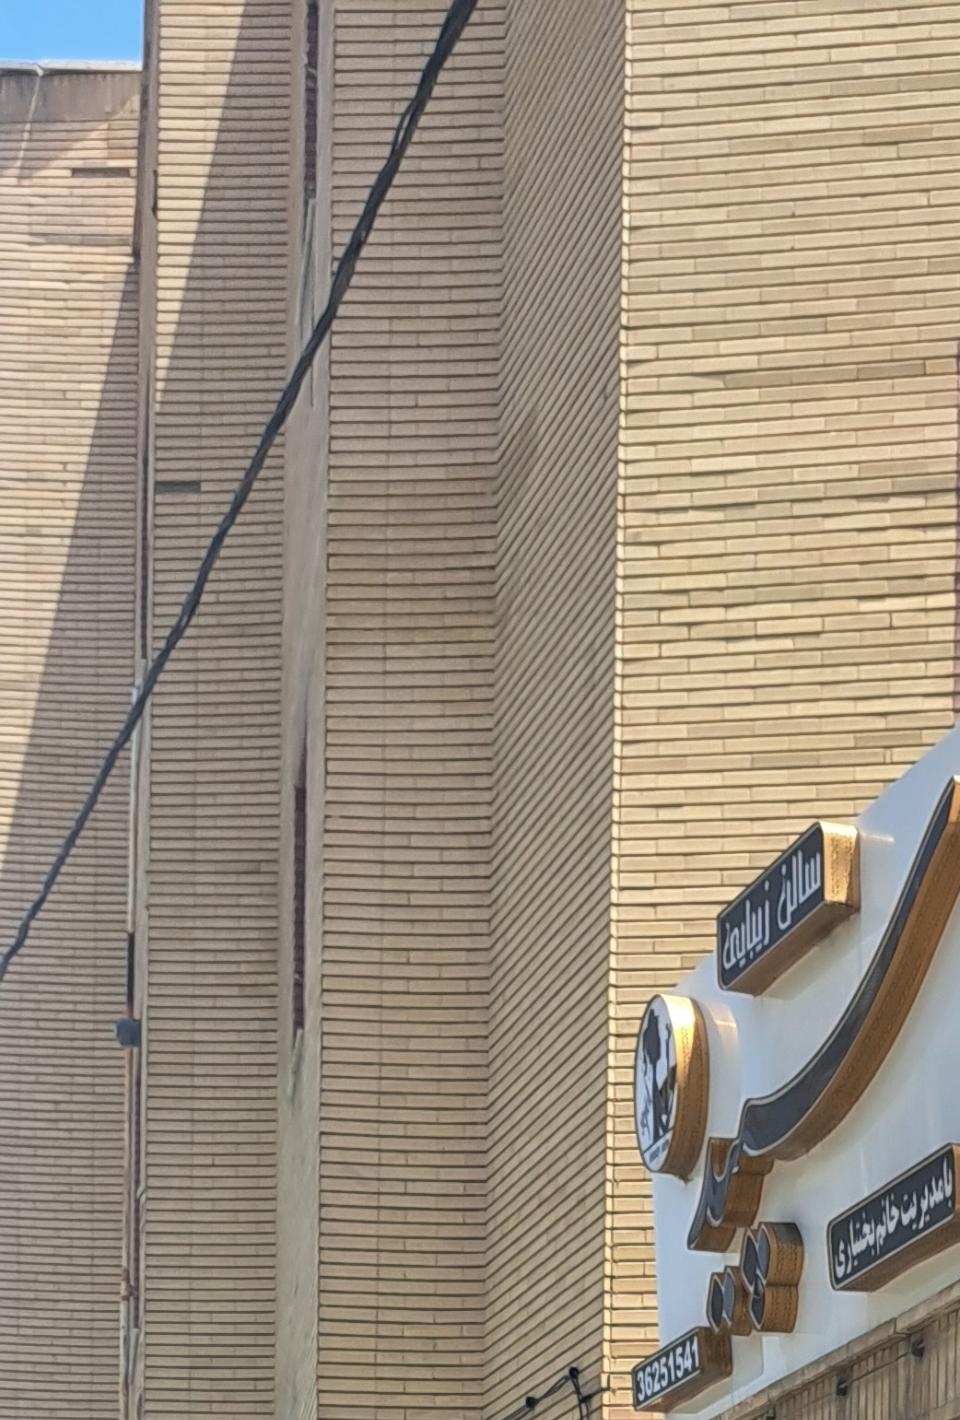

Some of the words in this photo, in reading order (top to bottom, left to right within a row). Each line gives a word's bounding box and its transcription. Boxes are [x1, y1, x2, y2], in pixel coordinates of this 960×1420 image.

[777, 850, 821, 930] سالن
[723, 880, 770, 970] زیبایی
[834, 1211, 875, 1279] بختیاری
[876, 1193, 900, 1256] خانم
[637, 1335, 699, 1401] 36251541
